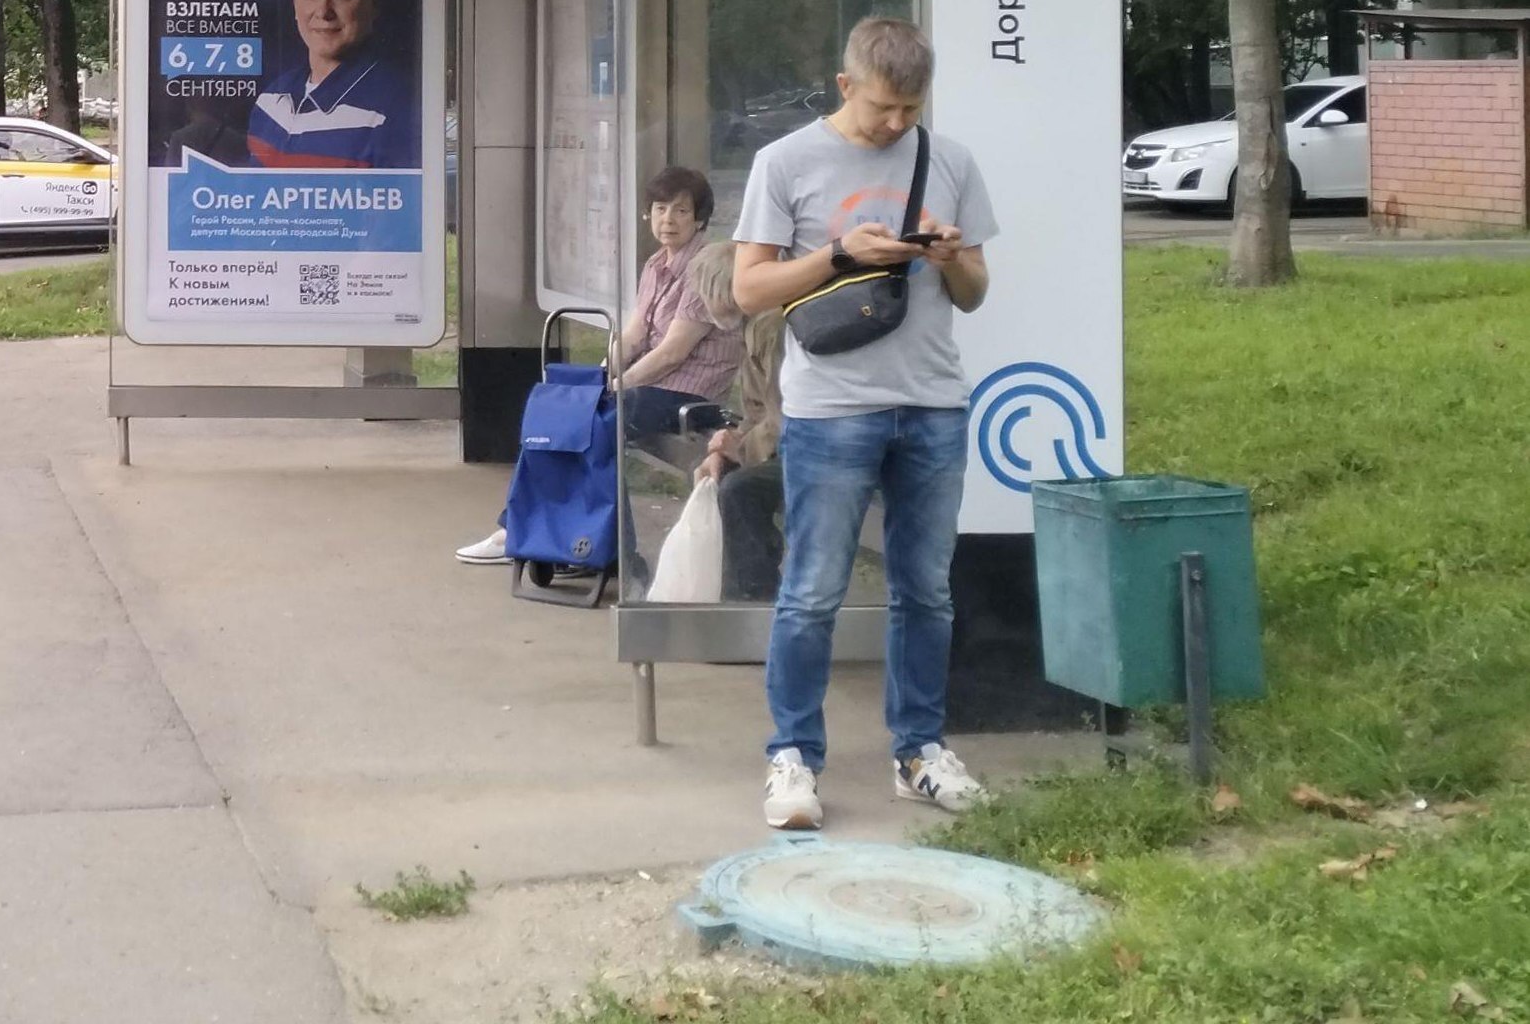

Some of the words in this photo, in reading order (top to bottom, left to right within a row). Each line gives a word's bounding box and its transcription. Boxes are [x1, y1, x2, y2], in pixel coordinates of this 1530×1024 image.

[166, 1, 258, 17] ВЗЛЕТАЕМ
[166, 20, 195, 33] ВСЕ
[199, 20, 259, 34] ВМЕСТЕ
[168, 43, 194, 72] 6,
[205, 43, 226, 72] 7,
[236, 43, 254, 68] 8
[166, 80, 256, 97] СЕНТЯБРЯ
[45, 182, 81, 192] Яндекс
[83, 182, 97, 193] Go
[66, 194, 94, 206] Такси
[192, 187, 255, 210] Олег
[261, 187, 403, 211] АРТЕМЬЕВ
[30, 206, 50, 215] (495)
[191, 215, 219, 225] Герой
[221, 216, 256, 226] России,
[190, 228, 227, 237] депутат
[230, 227, 288, 237] Московской
[290, 228, 339, 238] городской
[341, 228, 368, 238] Думы
[168, 260, 218, 273] Только
[222, 261, 278, 276] вперёд!
[169, 277, 179, 289] К
[183, 281, 230, 289] новым
[168, 294, 269, 307] достижениям!
